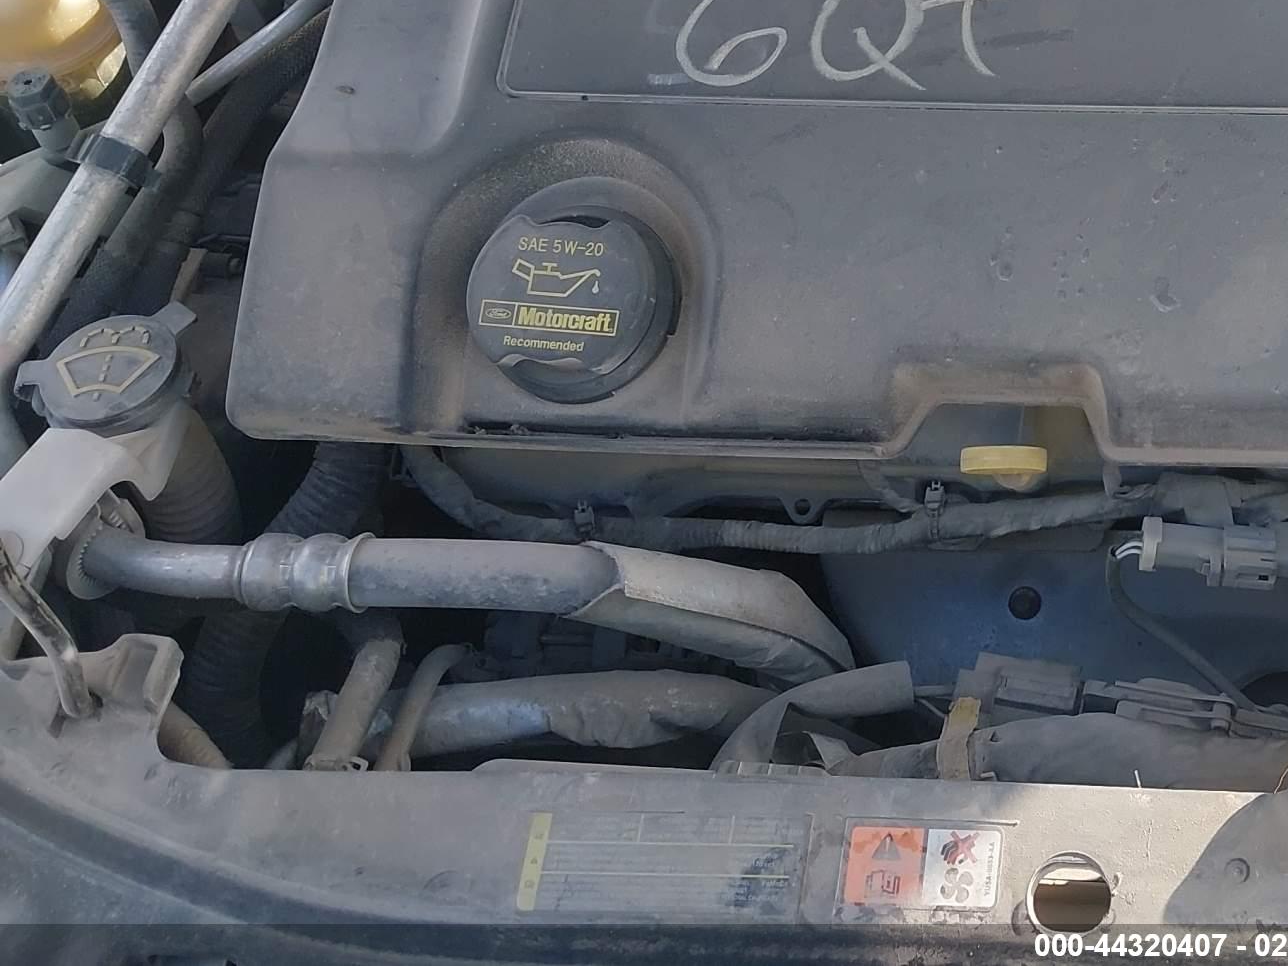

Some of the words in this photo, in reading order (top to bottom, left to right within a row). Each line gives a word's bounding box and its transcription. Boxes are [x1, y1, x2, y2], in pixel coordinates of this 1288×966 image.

[518, 236, 549, 252] SAE
[552, 239, 605, 257] 5W-20
[518, 306, 611, 332] Motorcraft
[503, 335, 585, 352] Recommended
